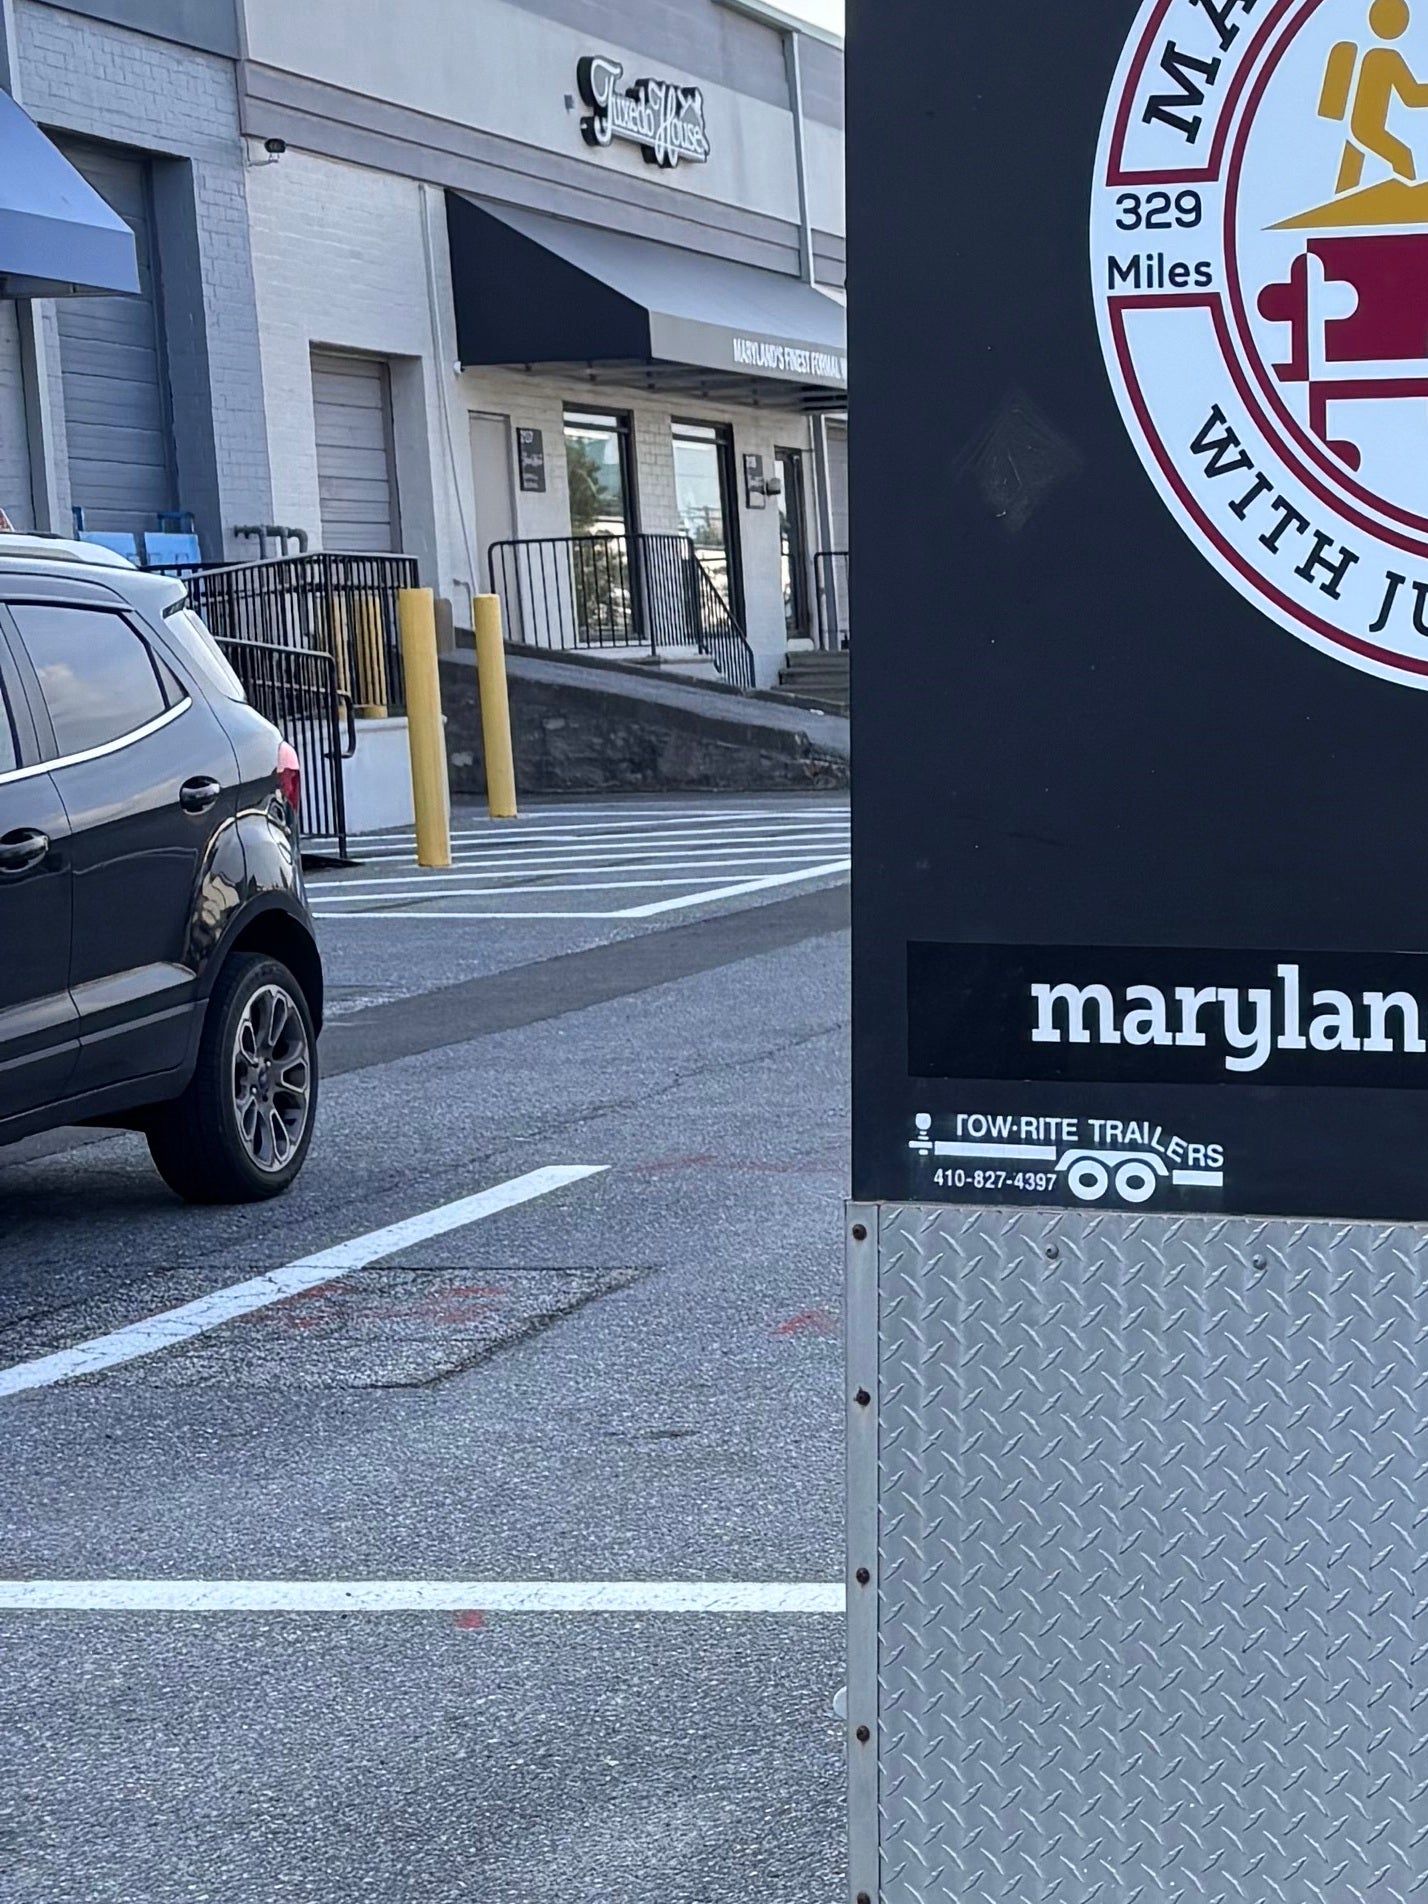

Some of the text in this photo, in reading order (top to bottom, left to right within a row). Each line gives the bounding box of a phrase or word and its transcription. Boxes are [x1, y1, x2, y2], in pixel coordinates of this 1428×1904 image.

[590, 58, 708, 168] Tuxedo House
[1113, 190, 1203, 232] 329
[1107, 253, 1214, 289] Miles
[1187, 403, 1359, 600] WITH
[1087, 1118, 1225, 1169] TRAILERS
[933, 1168, 1057, 1192] 410-827-4397
